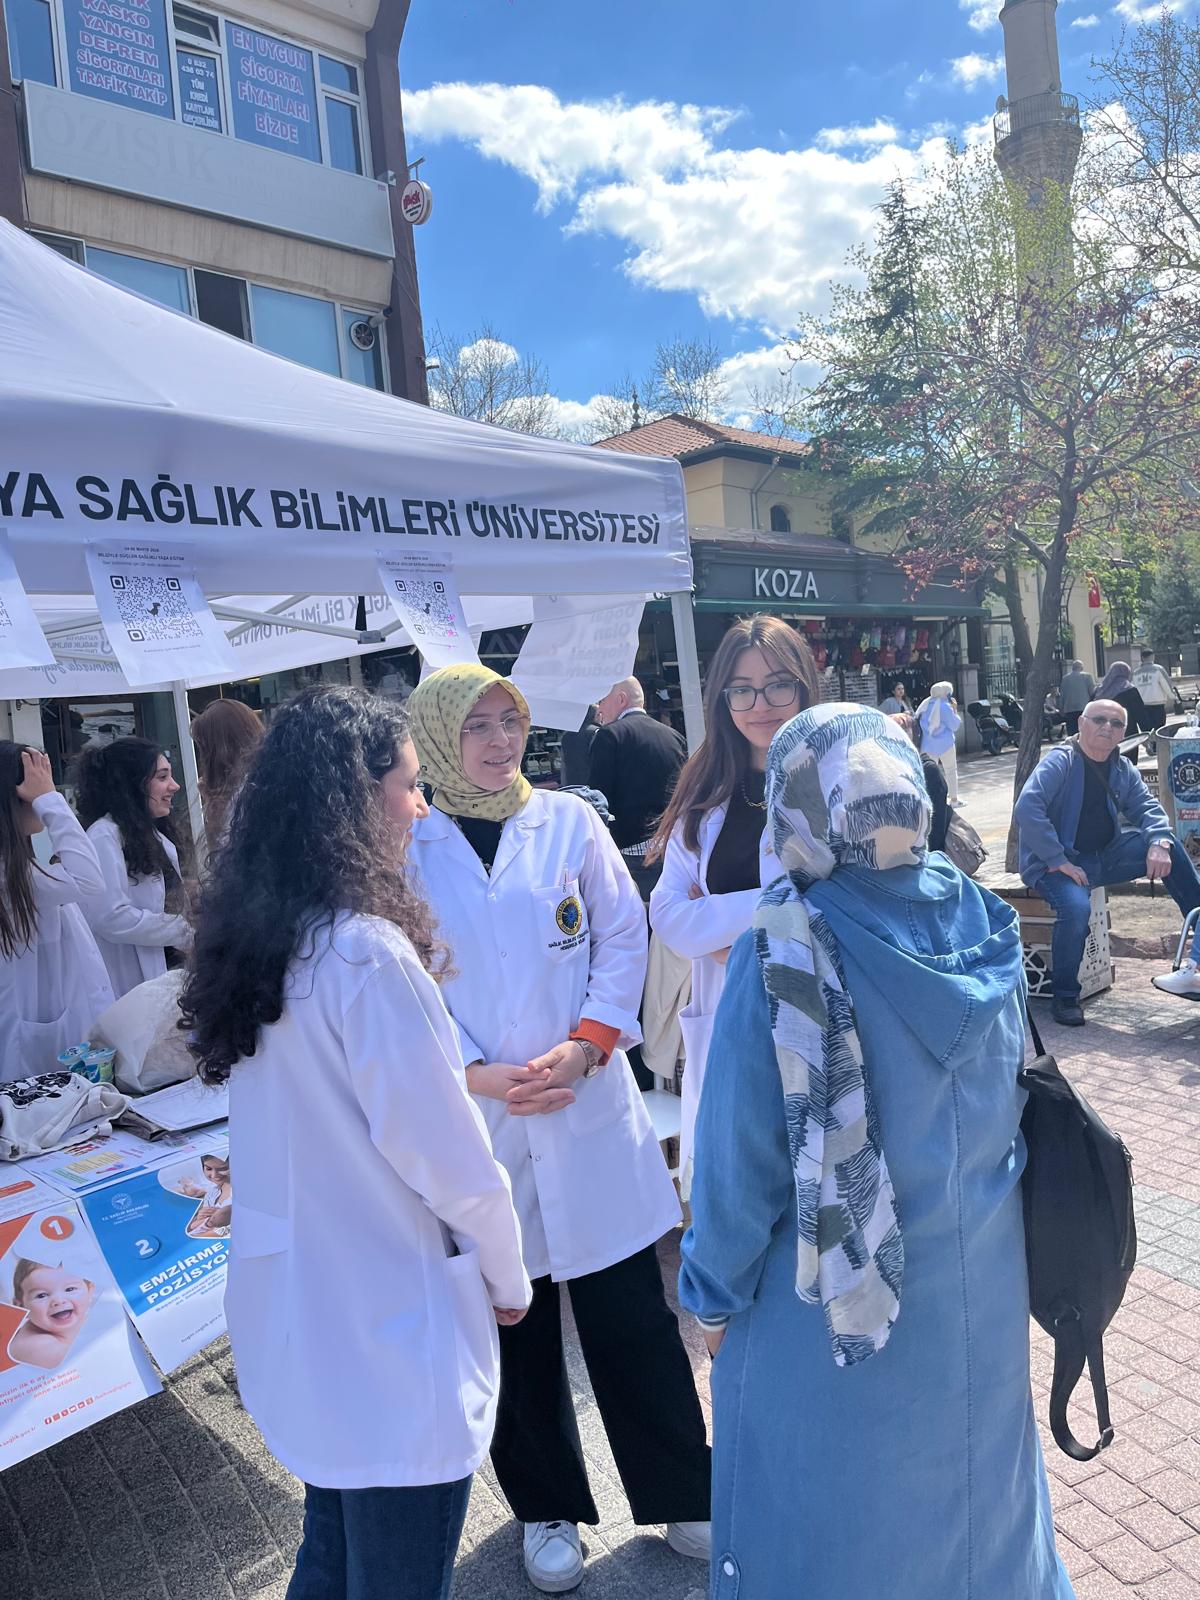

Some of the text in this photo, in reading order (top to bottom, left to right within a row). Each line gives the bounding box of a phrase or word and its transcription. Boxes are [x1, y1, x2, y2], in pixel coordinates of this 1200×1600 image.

[78, 11, 155, 49] YANGIN
[82, 0, 150, 28] KASKO
[77, 48, 165, 88] SİGORTALARI
[79, 31, 159, 68] DEPREM
[232, 28, 307, 71] EN UYGUN
[76, 66, 167, 106] TRAFİK TAKİP
[241, 56, 304, 96] SİGORTA
[238, 80, 310, 122] FİYATLARI
[255, 111, 299, 144] BİZDE
[75, 474, 263, 528] SAĞLIK
[754, 567, 819, 599] KOZA
[48, 1219, 63, 1236] 1
[135, 1239, 154, 1256] 2
[138, 1241, 225, 1294] EMZİRME
[145, 1249, 229, 1304] POZİSYO
